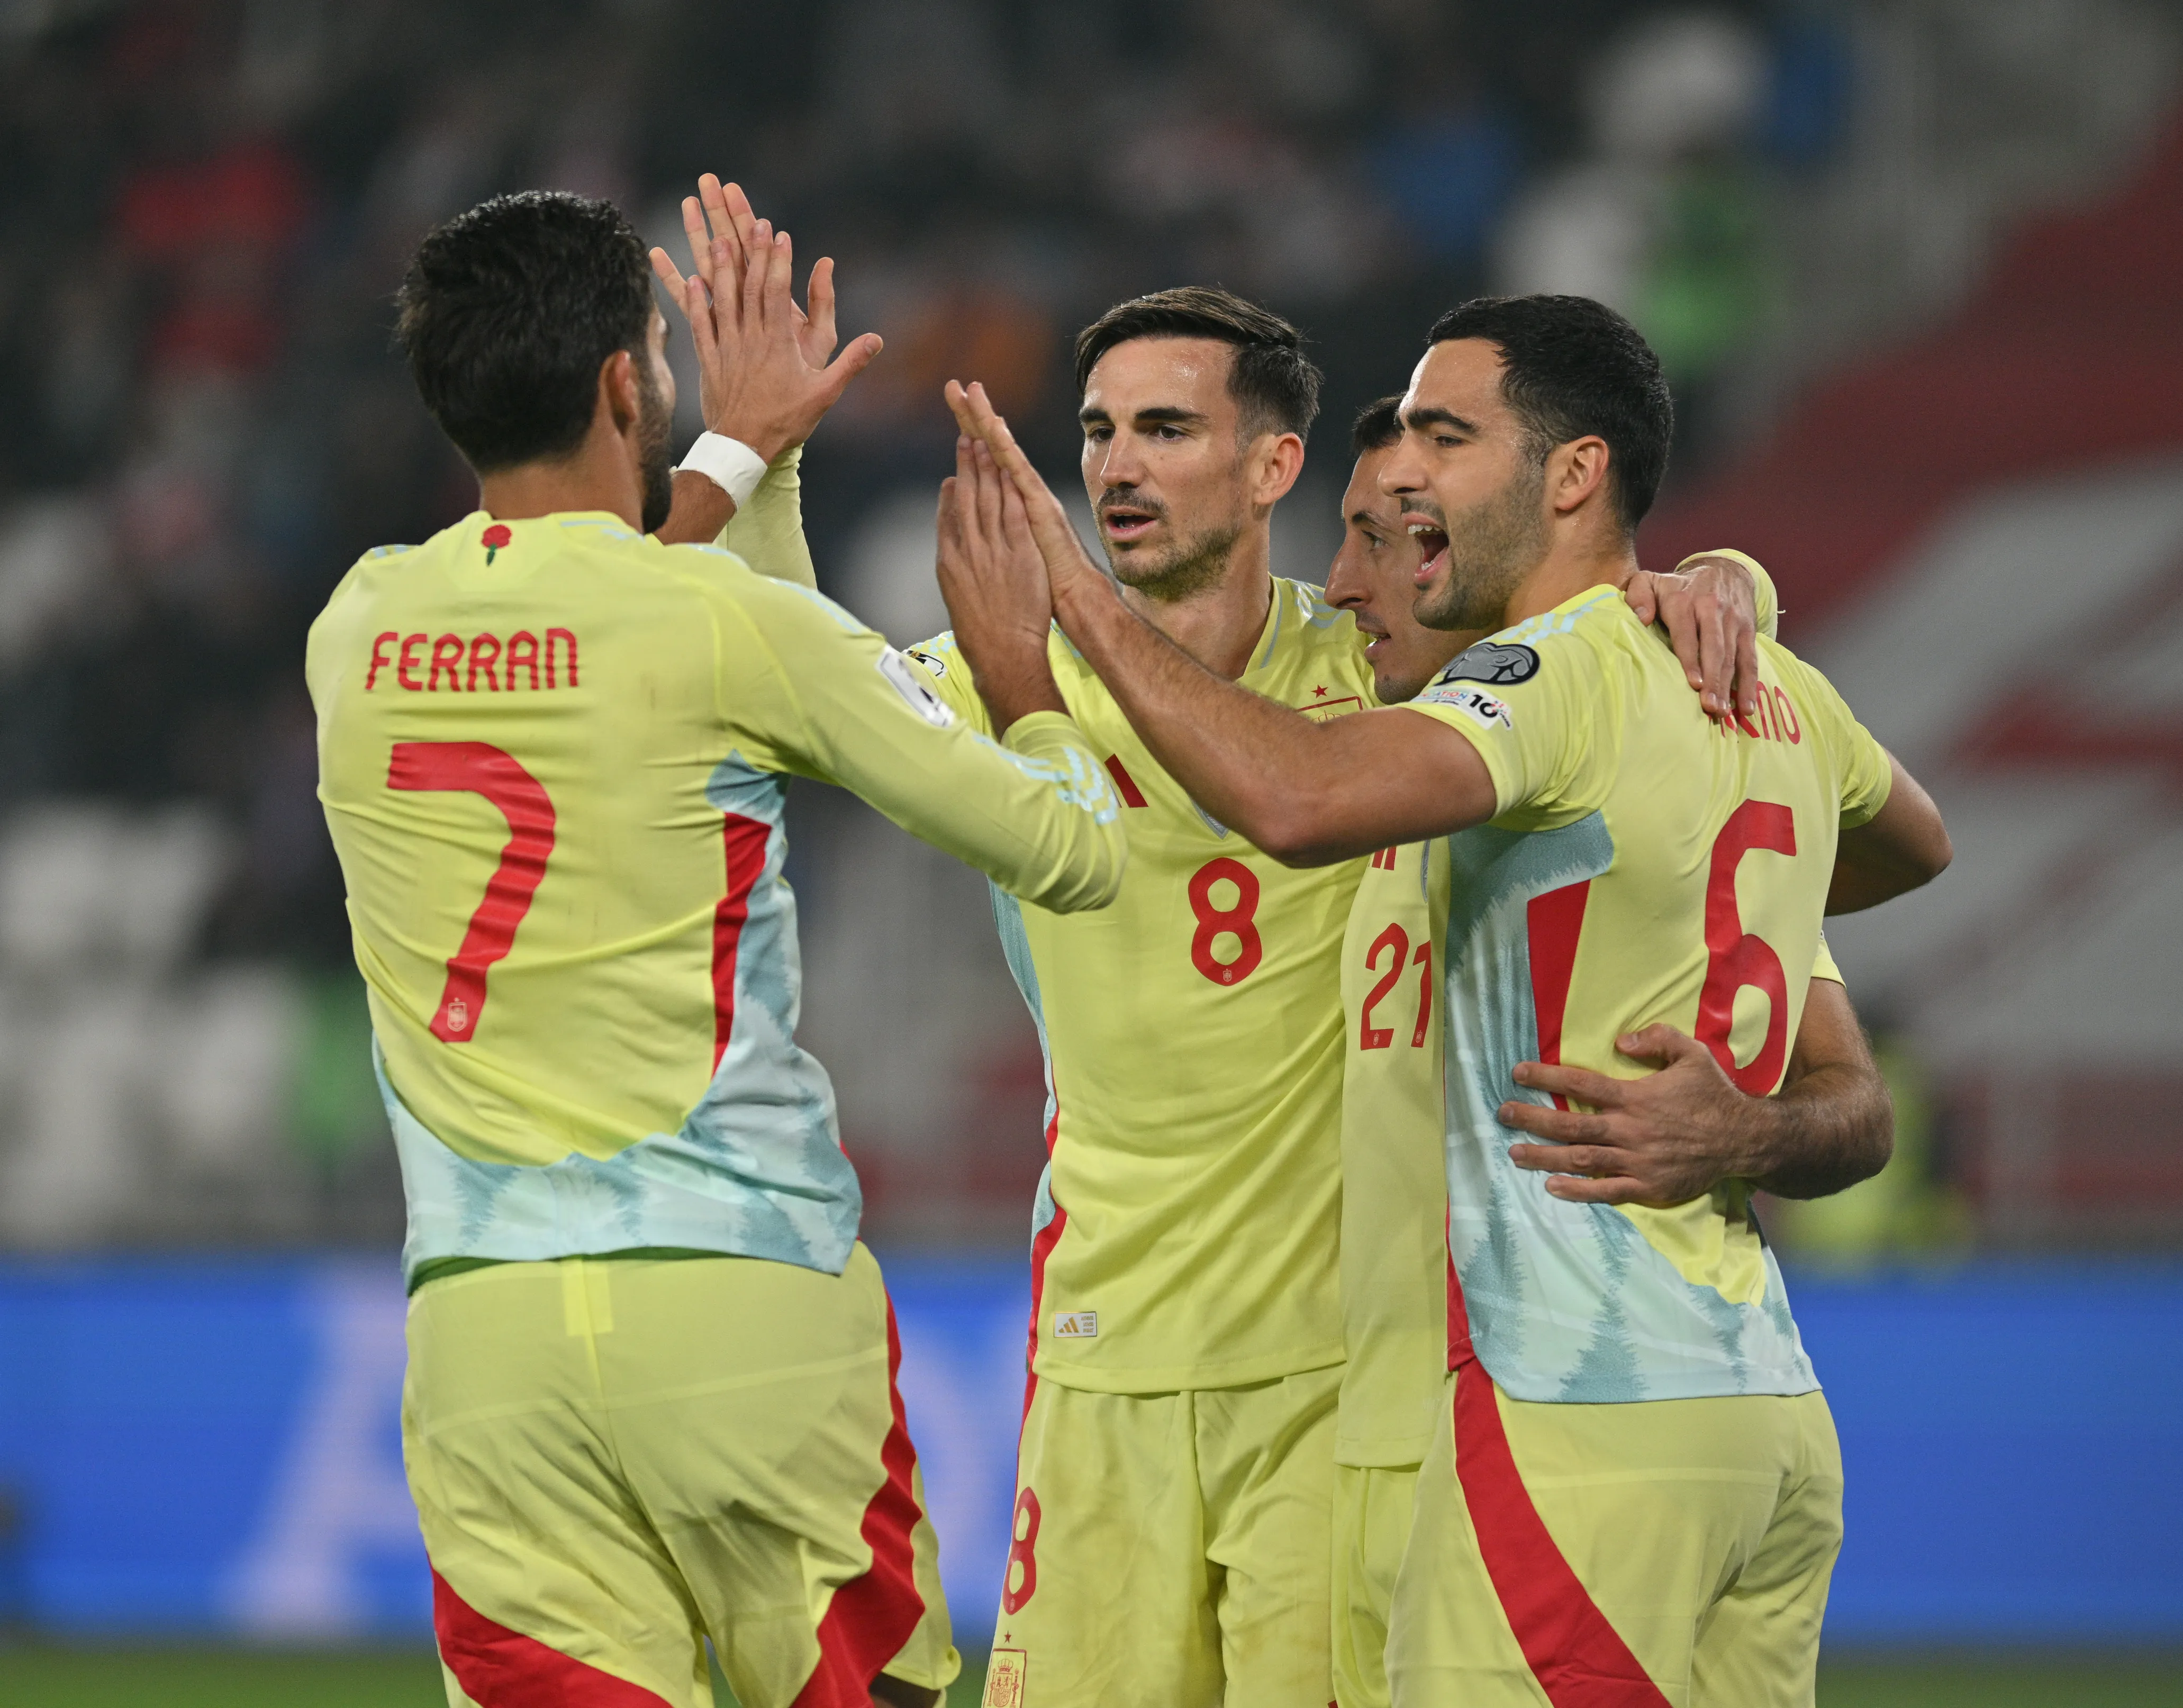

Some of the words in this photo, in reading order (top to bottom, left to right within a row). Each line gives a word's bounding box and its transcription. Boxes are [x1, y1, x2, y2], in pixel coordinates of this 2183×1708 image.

[365, 628, 578, 692] FERRAN
[386, 741, 556, 1042] 7
[1188, 857, 1262, 986] 8
[1695, 798, 1796, 1097] 6
[1360, 922, 1432, 1050] 21
[1002, 1486, 1041, 1615] 8
